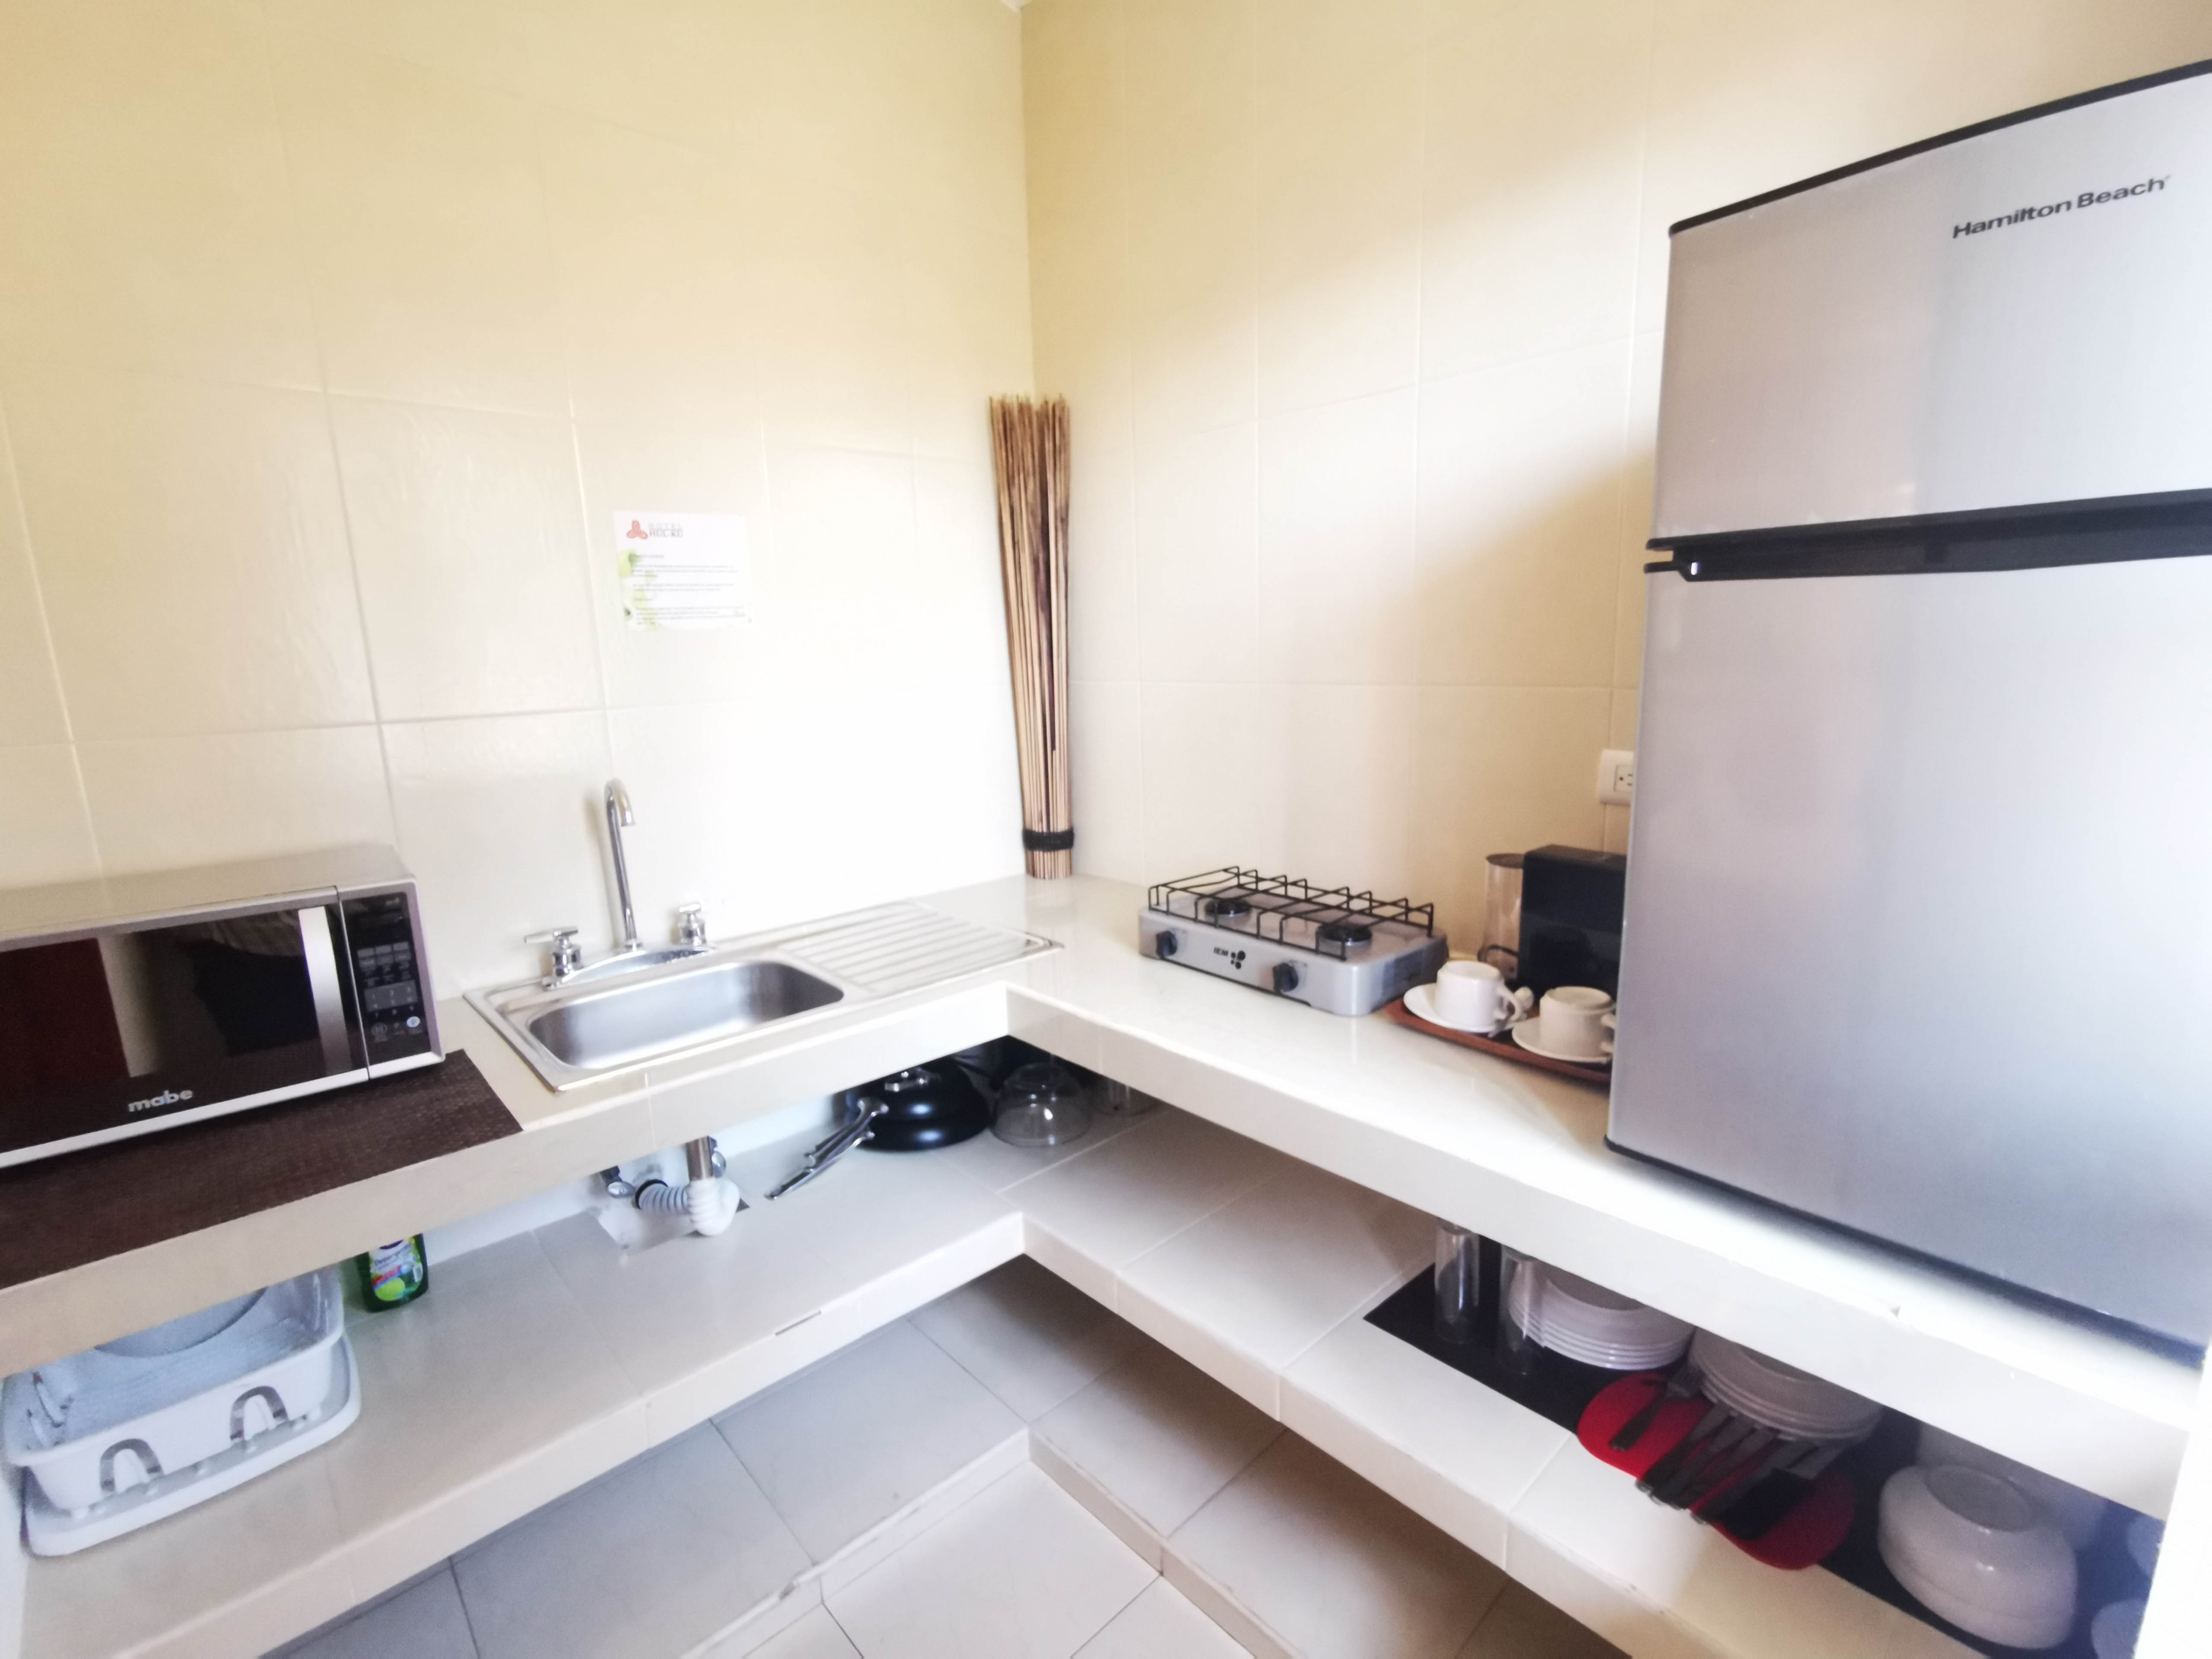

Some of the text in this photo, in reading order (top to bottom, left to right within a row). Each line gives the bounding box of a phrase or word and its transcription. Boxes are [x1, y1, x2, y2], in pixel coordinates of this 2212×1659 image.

[1952, 177, 2164, 238] Hamilton Beach
[128, 1090, 193, 1112] mabe
